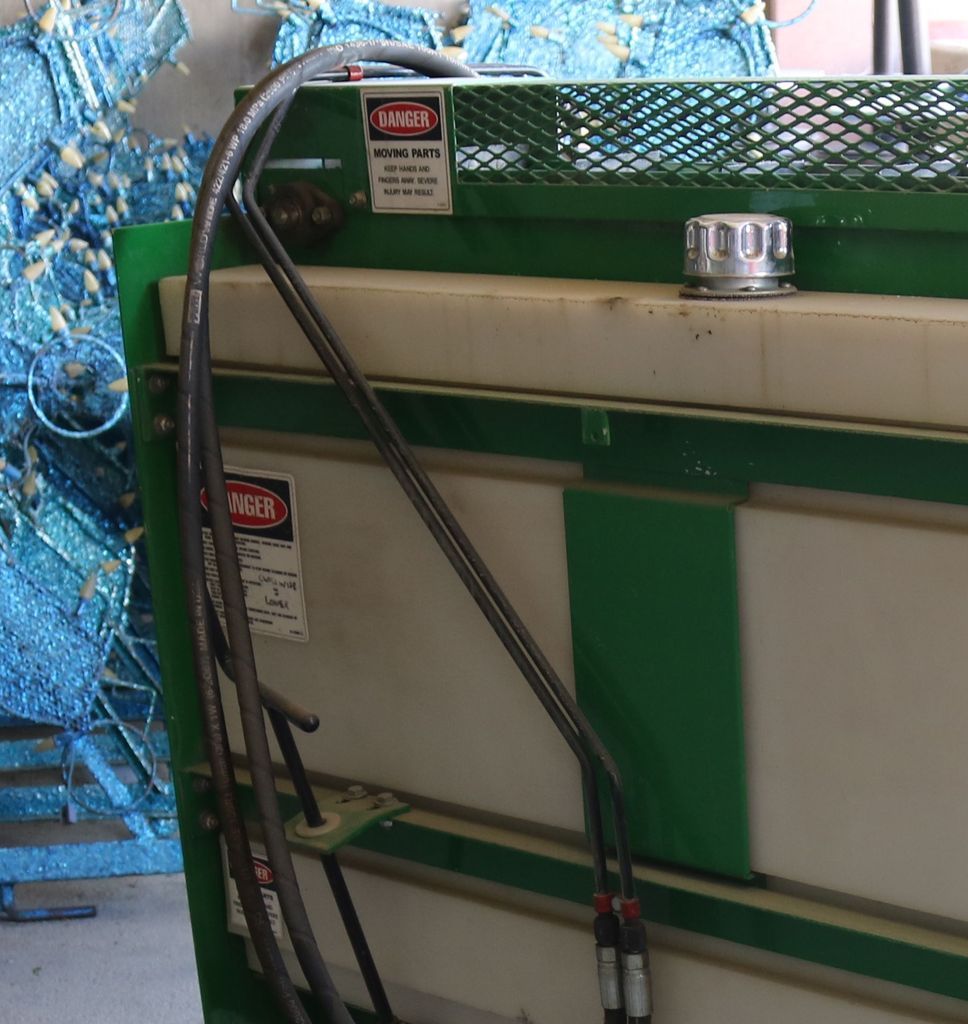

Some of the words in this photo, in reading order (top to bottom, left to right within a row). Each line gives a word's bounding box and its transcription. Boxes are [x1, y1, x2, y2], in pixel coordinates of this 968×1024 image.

[378, 110, 430, 128] DANGER
[373, 148, 409, 158] MOVING
[411, 148, 441, 158] PARTS
[418, 165, 430, 173] AND
[417, 177, 438, 185] SEVERE
[402, 188, 413, 196] MAY
[227, 491, 276, 520] NGER
